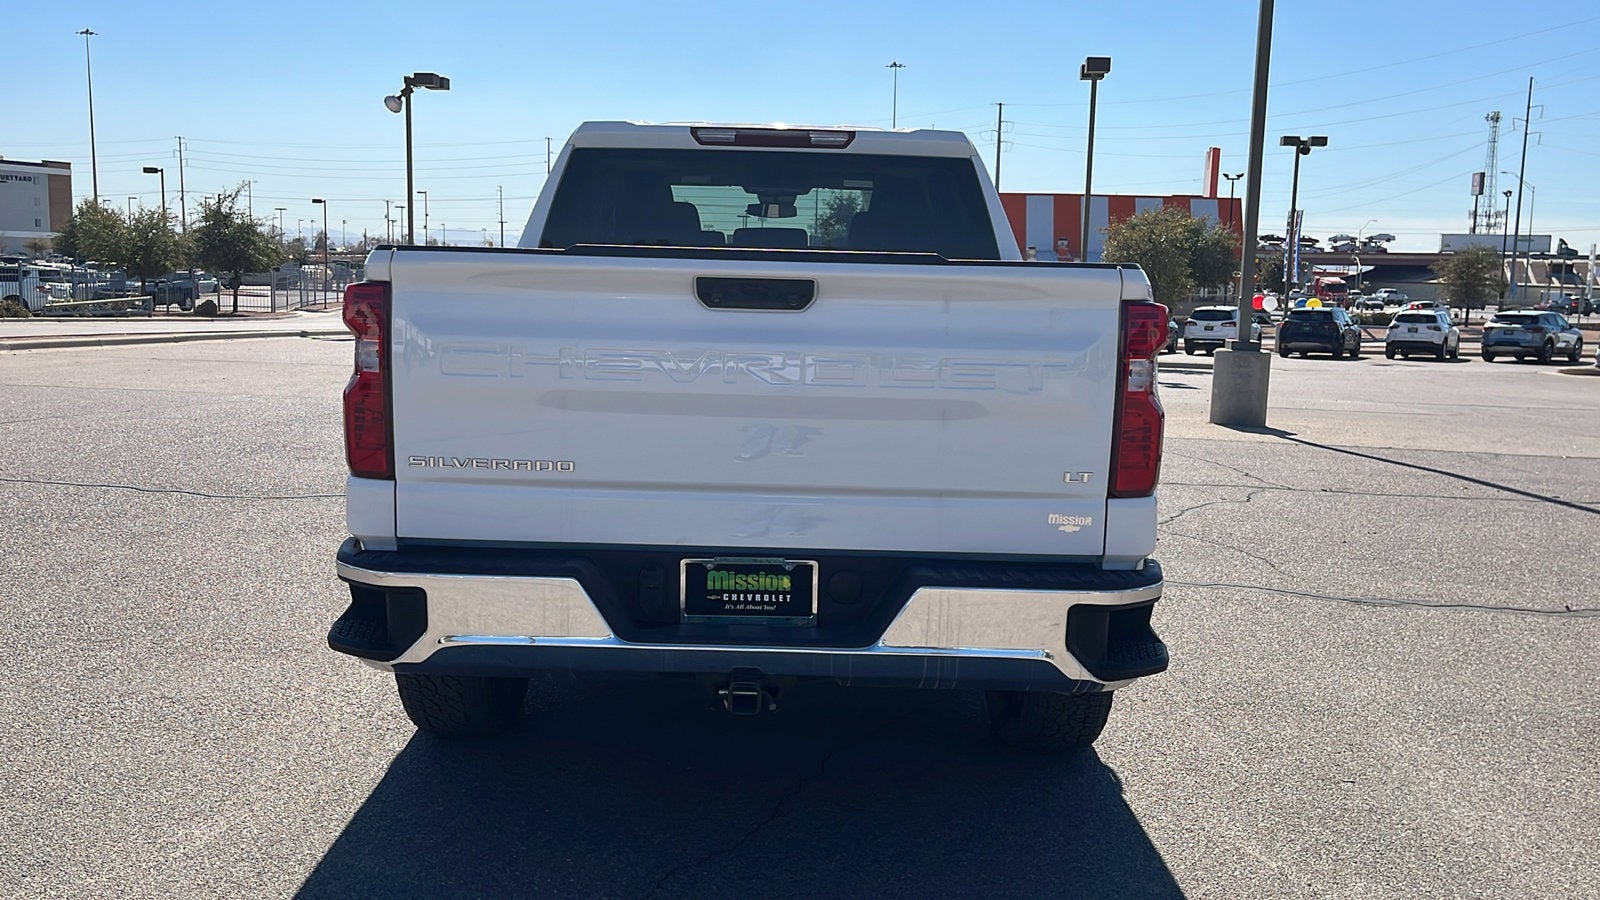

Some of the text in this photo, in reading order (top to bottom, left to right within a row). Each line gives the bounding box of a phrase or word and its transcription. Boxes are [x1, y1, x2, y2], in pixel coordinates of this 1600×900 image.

[439, 341, 1073, 392] CHEVROLET
[408, 455, 576, 472] SILVERADO
[1063, 471, 1094, 483] LT
[1048, 513, 1093, 526] Mission
[707, 570, 791, 591] Mission
[723, 593, 791, 602] CHEVROLET
